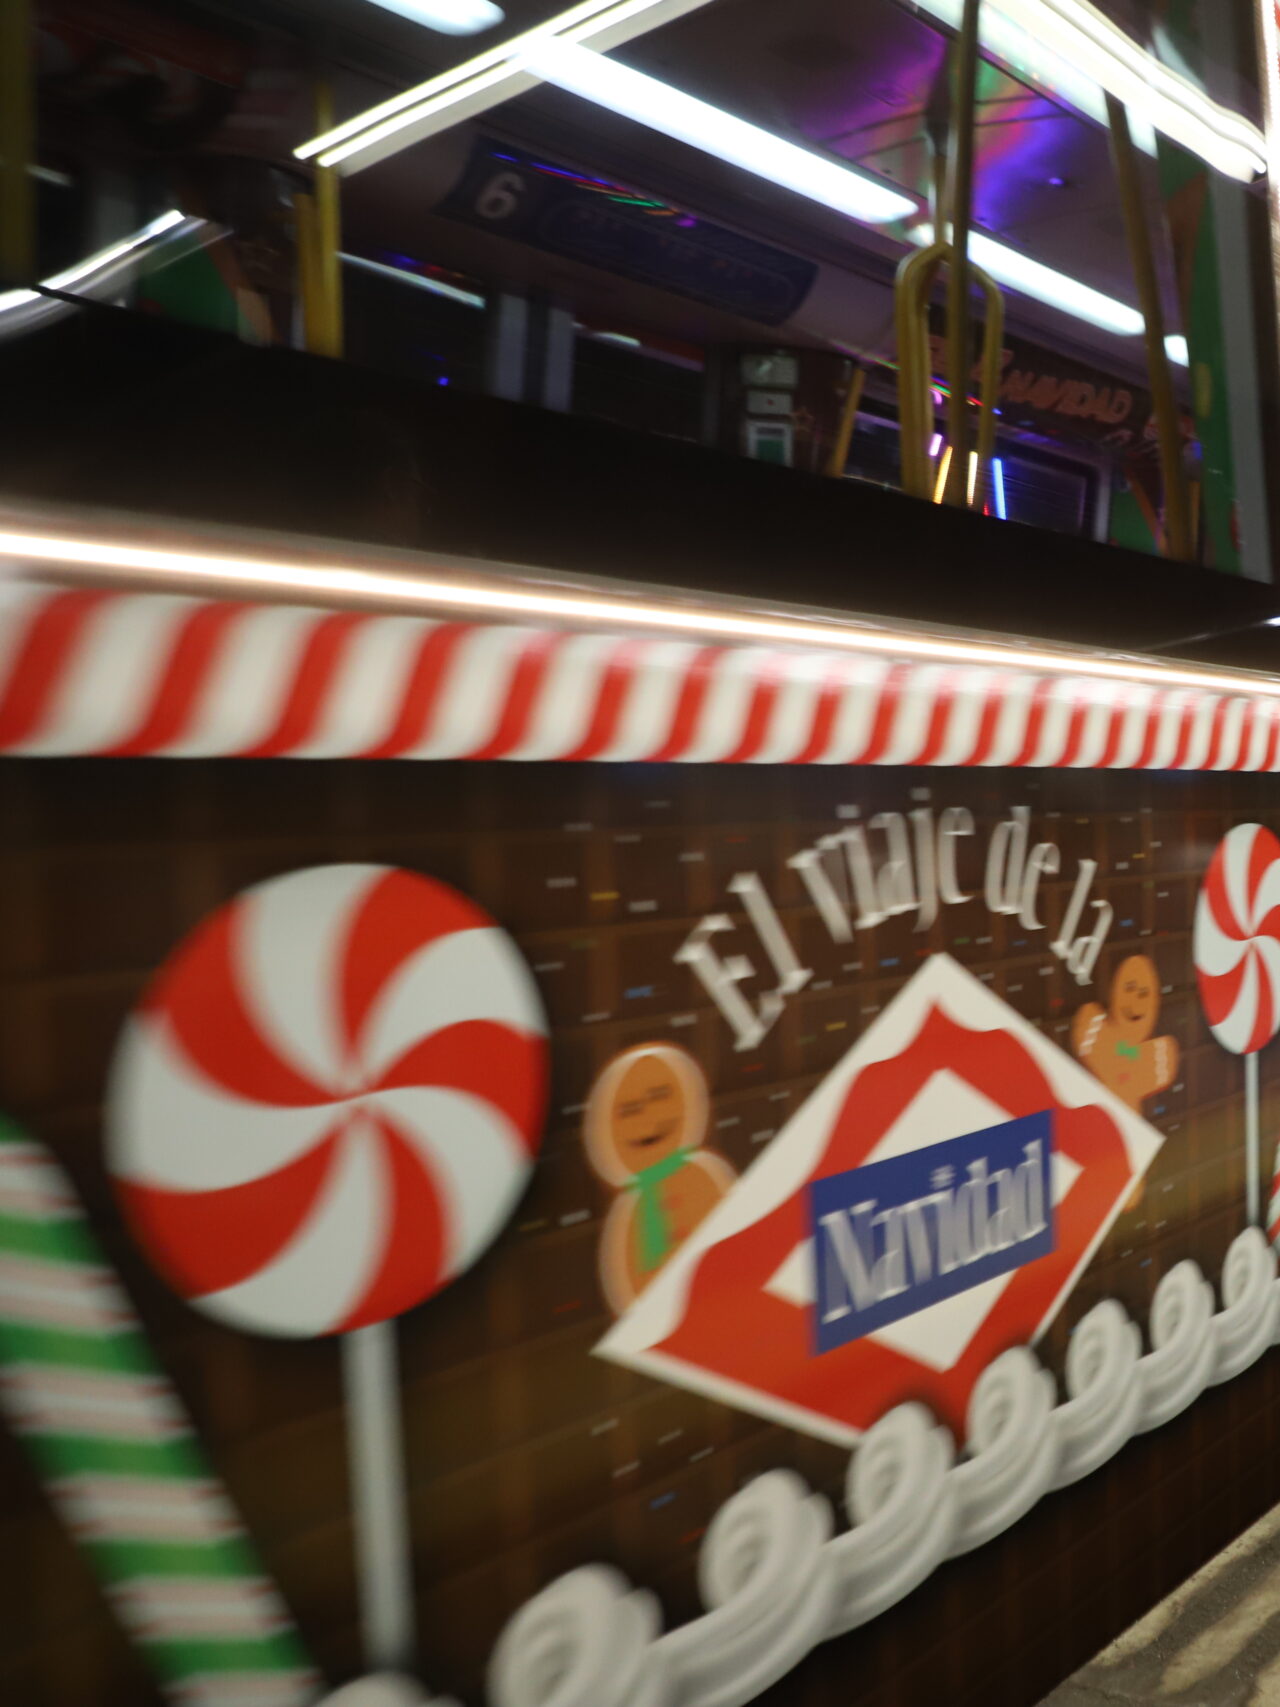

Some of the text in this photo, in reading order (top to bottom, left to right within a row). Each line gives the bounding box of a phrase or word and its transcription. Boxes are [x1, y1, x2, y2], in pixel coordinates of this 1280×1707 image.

[475, 172, 526, 219] 6
[675, 787, 1114, 1052] El viaje de la
[819, 1138, 1049, 1325] Navidad
